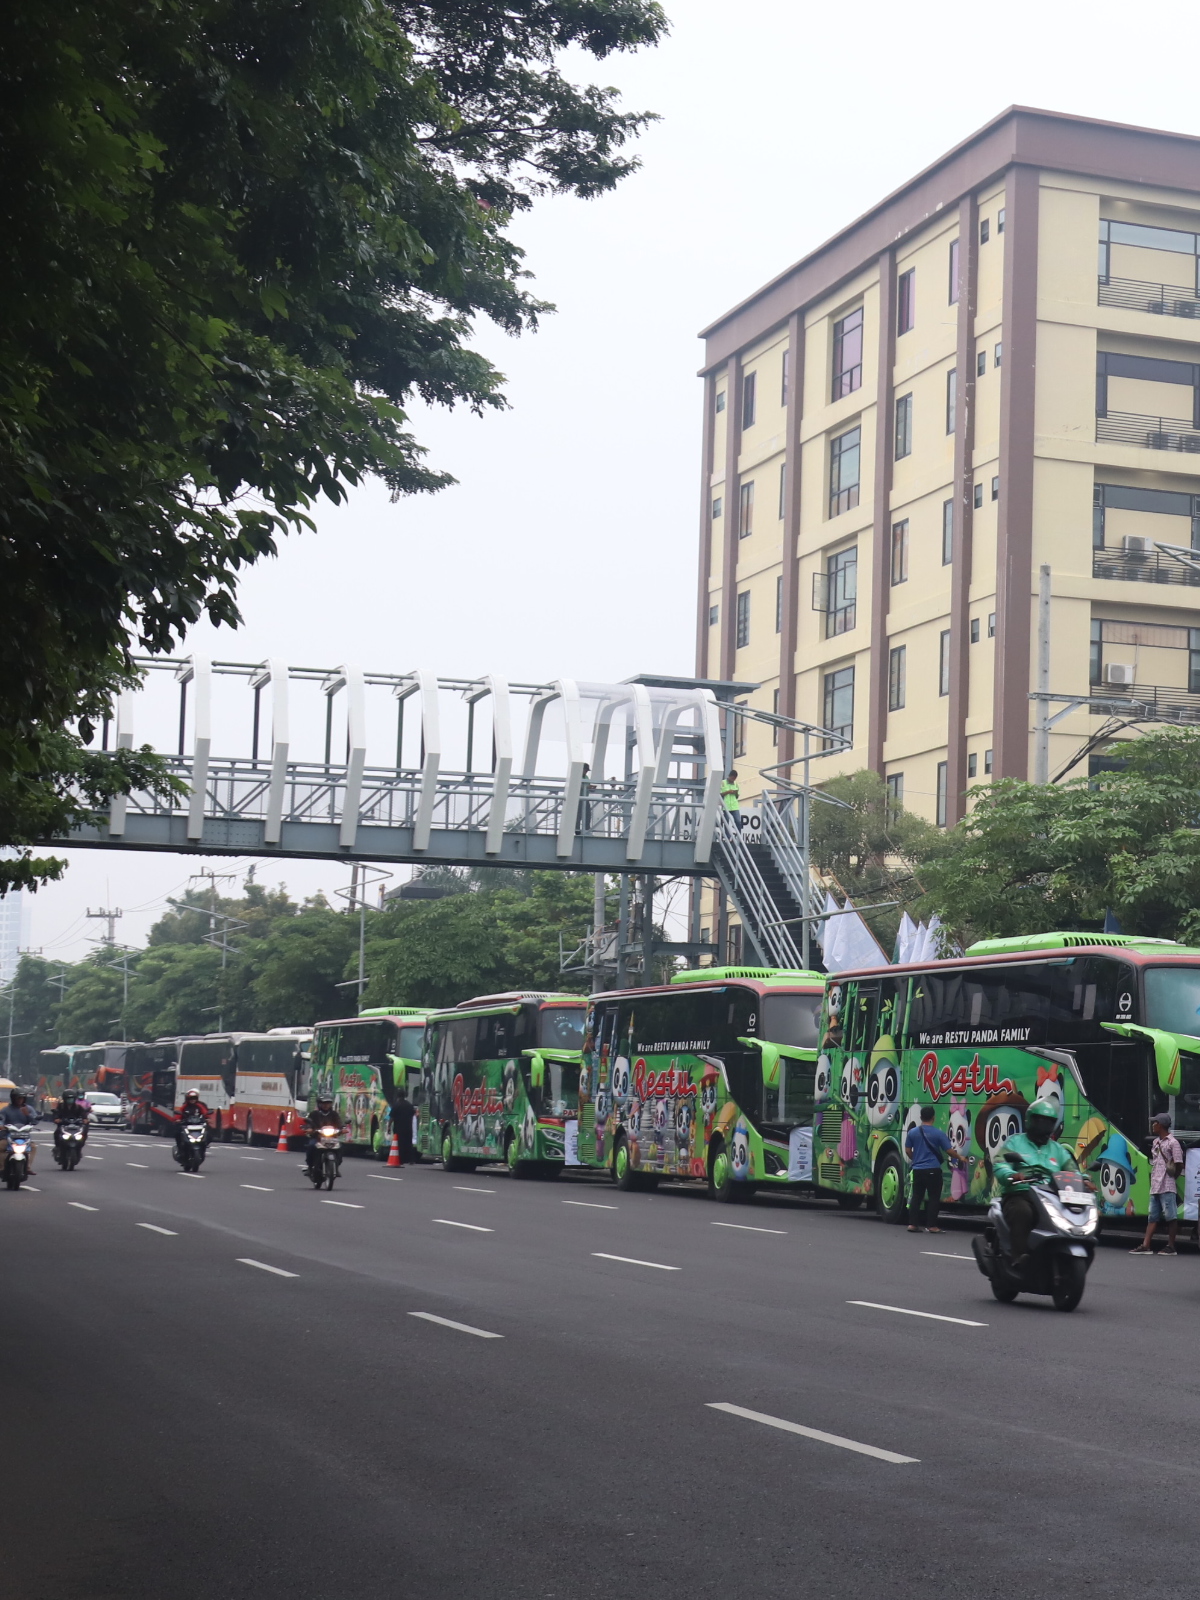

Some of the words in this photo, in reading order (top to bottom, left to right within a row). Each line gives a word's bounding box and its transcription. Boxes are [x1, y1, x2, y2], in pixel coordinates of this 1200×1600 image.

[653, 1042, 671, 1051] RESTU
[671, 1041, 689, 1050] PANDA
[690, 1040, 711, 1050] FAMILY
[920, 1033, 931, 1044] We
[931, 1034, 943, 1044] are
[944, 1031, 970, 1043] RESTU
[971, 1030, 998, 1042] PANDA
[1000, 1028, 1031, 1041] FAMILY
[452, 1072, 504, 1124] Restu
[631, 1057, 698, 1104] Restu
[917, 1050, 1013, 1102] Restu
